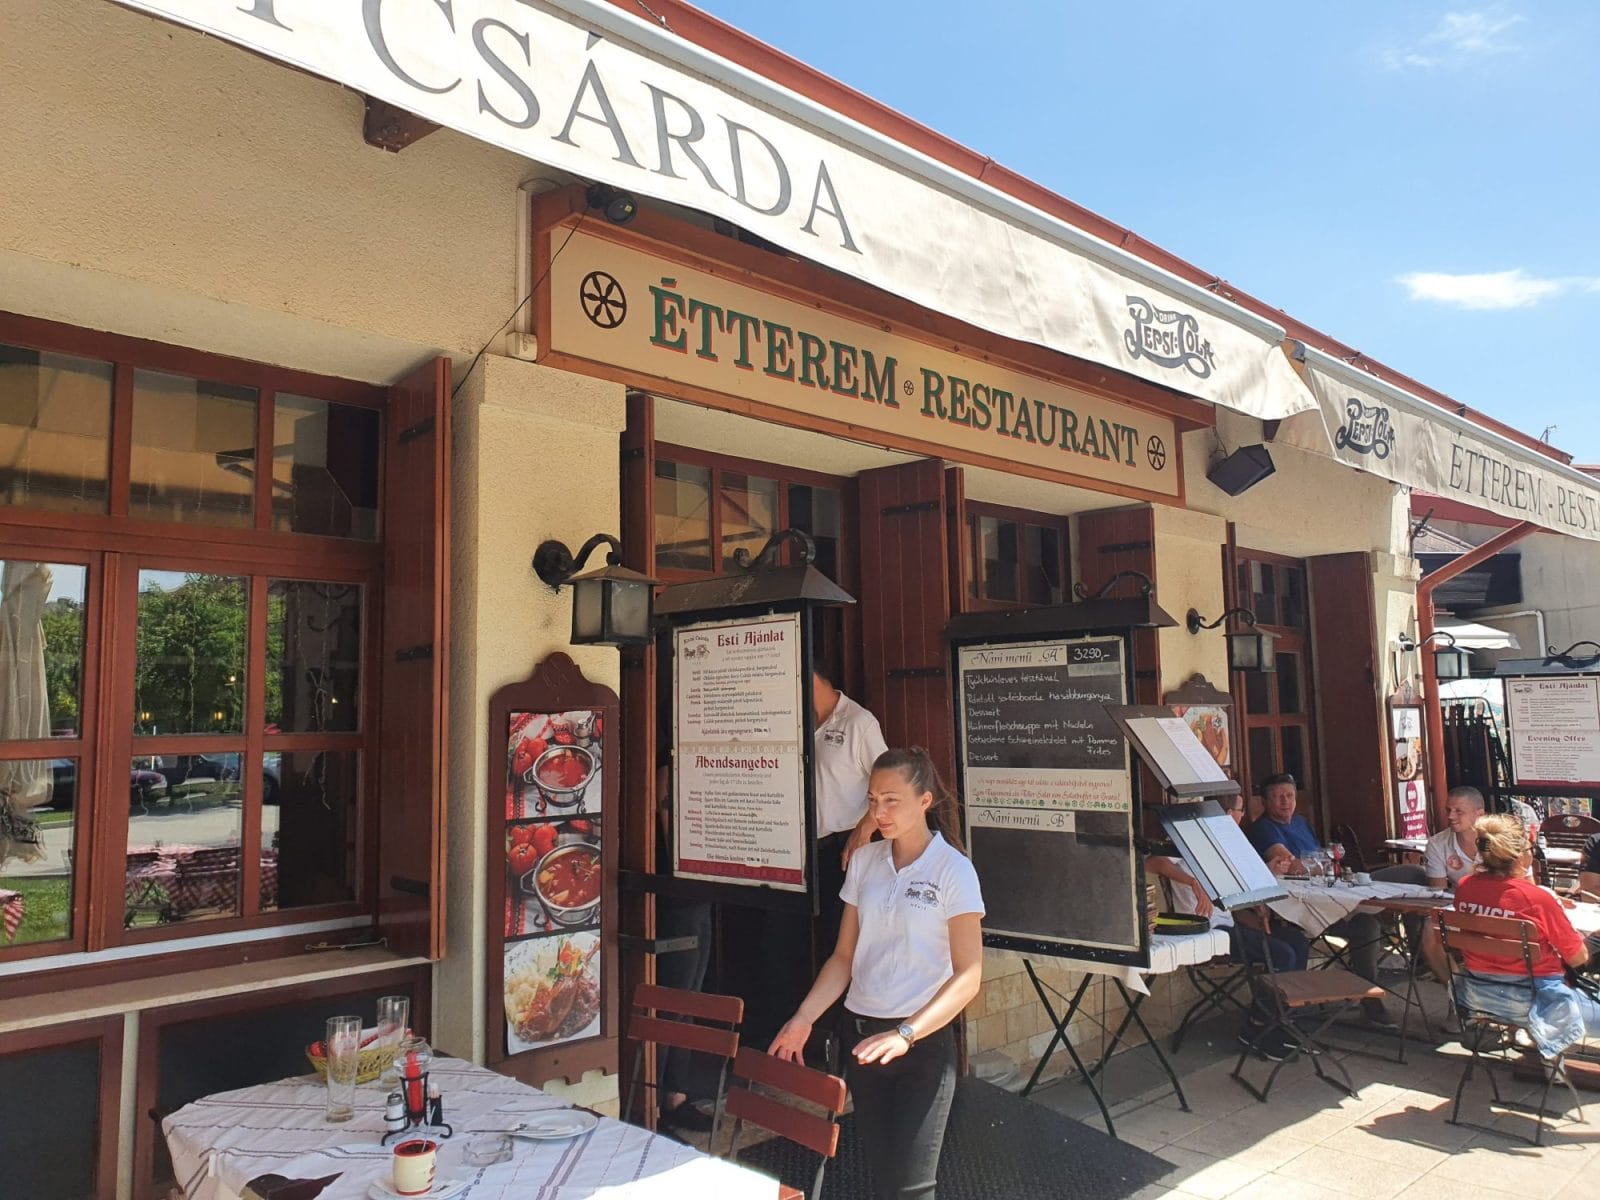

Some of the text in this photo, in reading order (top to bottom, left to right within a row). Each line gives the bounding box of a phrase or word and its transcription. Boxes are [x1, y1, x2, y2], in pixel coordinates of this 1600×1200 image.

[362, 0, 863, 255] CSÁRDA
[649, 277, 1139, 468] ÉTTEREM RESTAURANT
[1449, 431, 1543, 515] ÉTTEREM
[717, 629, 785, 647] Esti Ajánlat
[1005, 652, 1032, 663] menü
[1043, 720, 1059, 730] mit
[1062, 720, 1094, 730] Nudeln
[695, 755, 780, 771] Abendsangebot
[1013, 814, 1040, 826] menü
